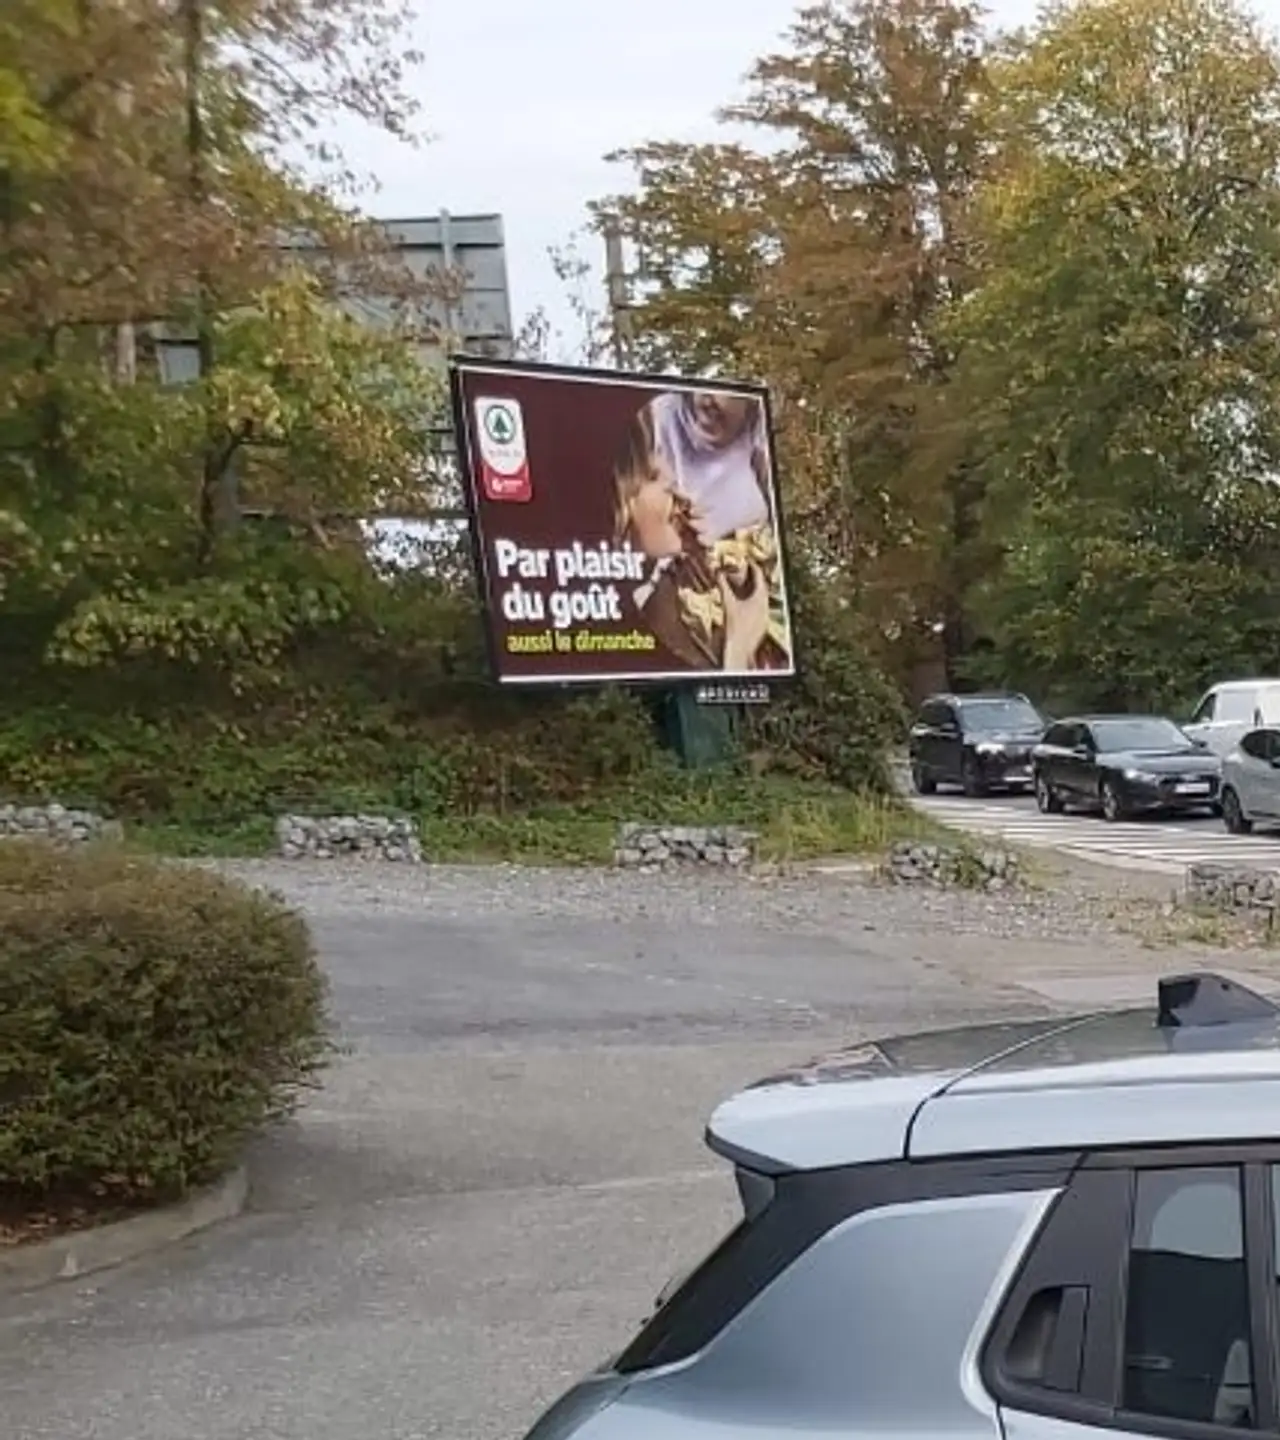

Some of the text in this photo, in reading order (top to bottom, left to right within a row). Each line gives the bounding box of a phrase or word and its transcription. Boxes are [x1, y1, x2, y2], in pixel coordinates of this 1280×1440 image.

[495, 539, 645, 586] Par plaisir
[503, 581, 622, 628] du goût
[507, 630, 552, 652] aussi
[575, 629, 655, 650] dimanche
